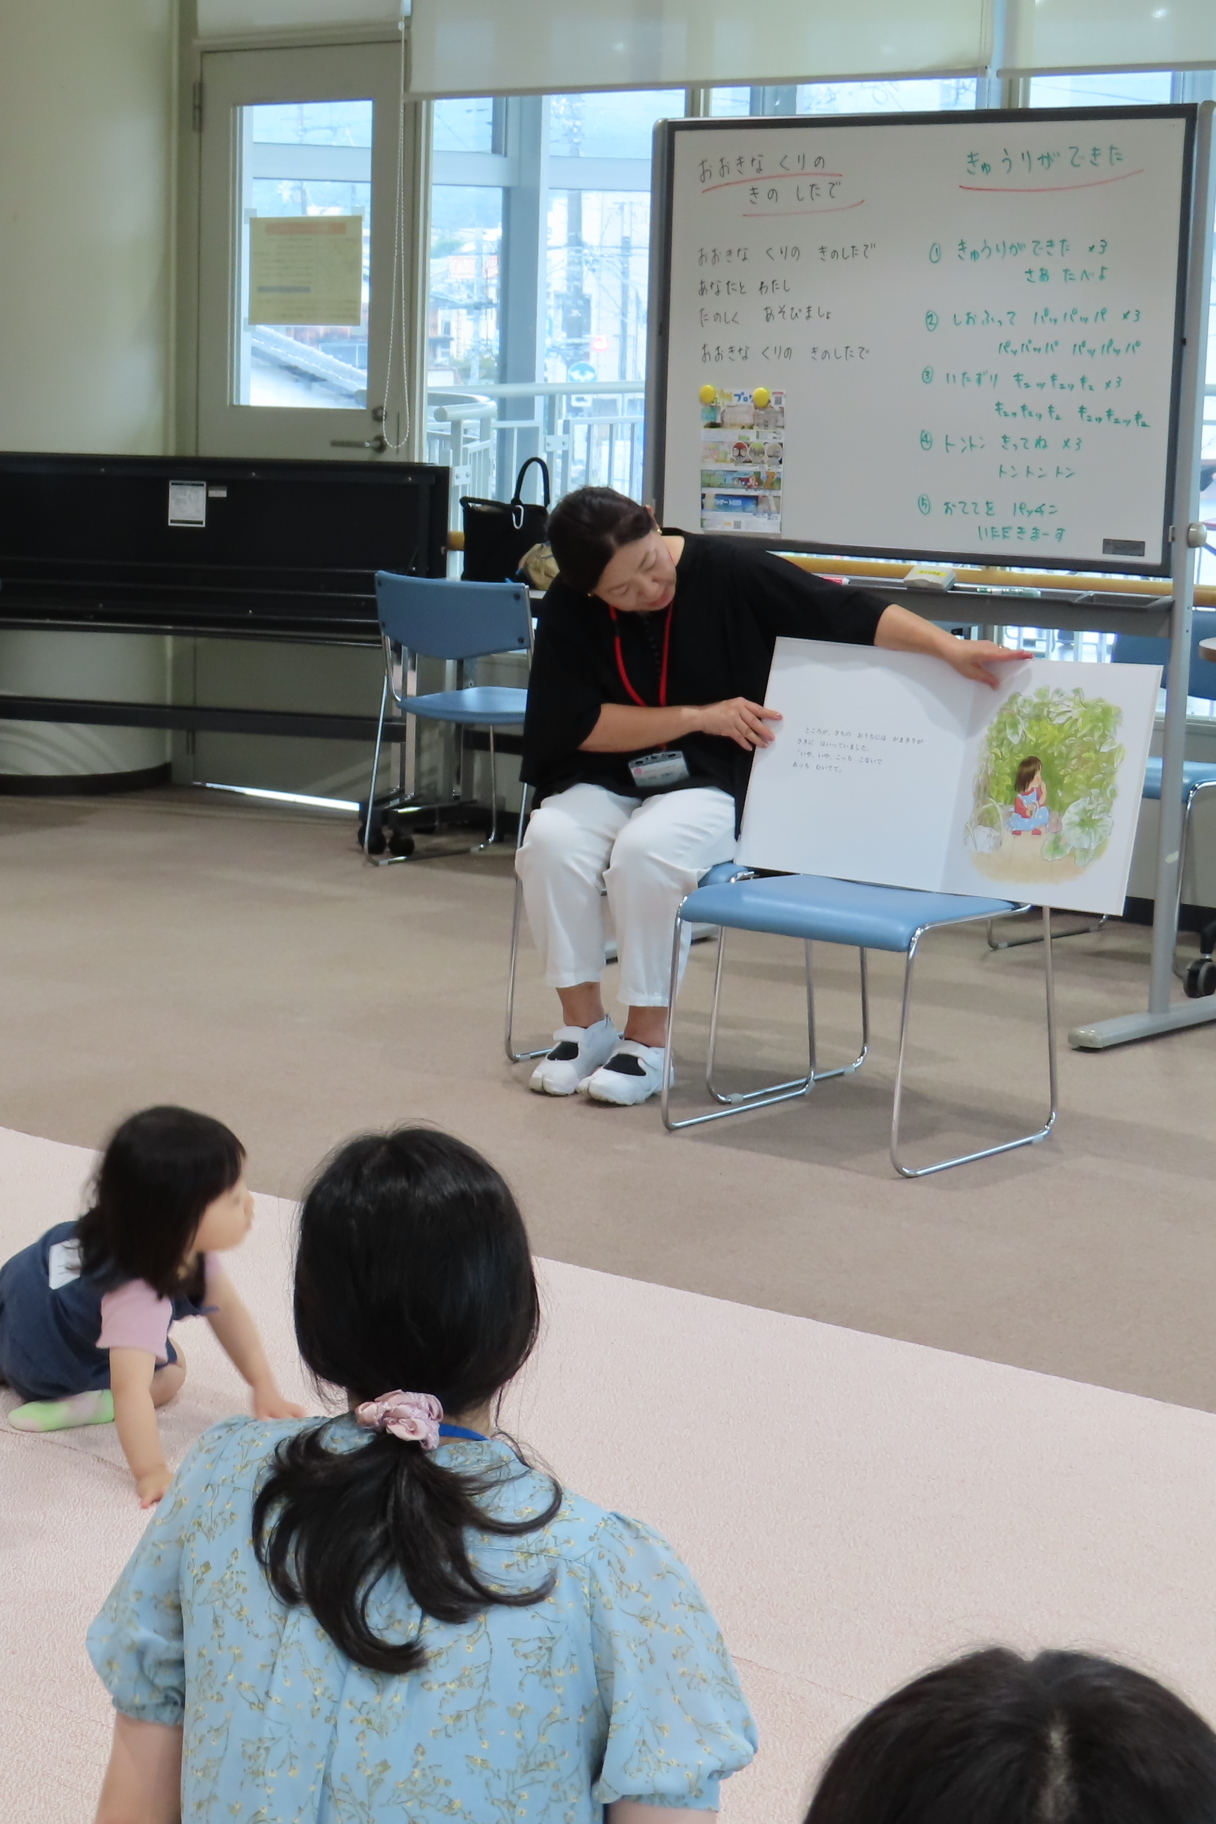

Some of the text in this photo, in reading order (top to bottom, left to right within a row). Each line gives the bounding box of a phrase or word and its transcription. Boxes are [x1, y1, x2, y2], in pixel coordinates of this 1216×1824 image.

[698, 153, 826, 184] おおきな くりの
[698, 279, 791, 297] あなたと わたし
[698, 307, 740, 328] たのしく
